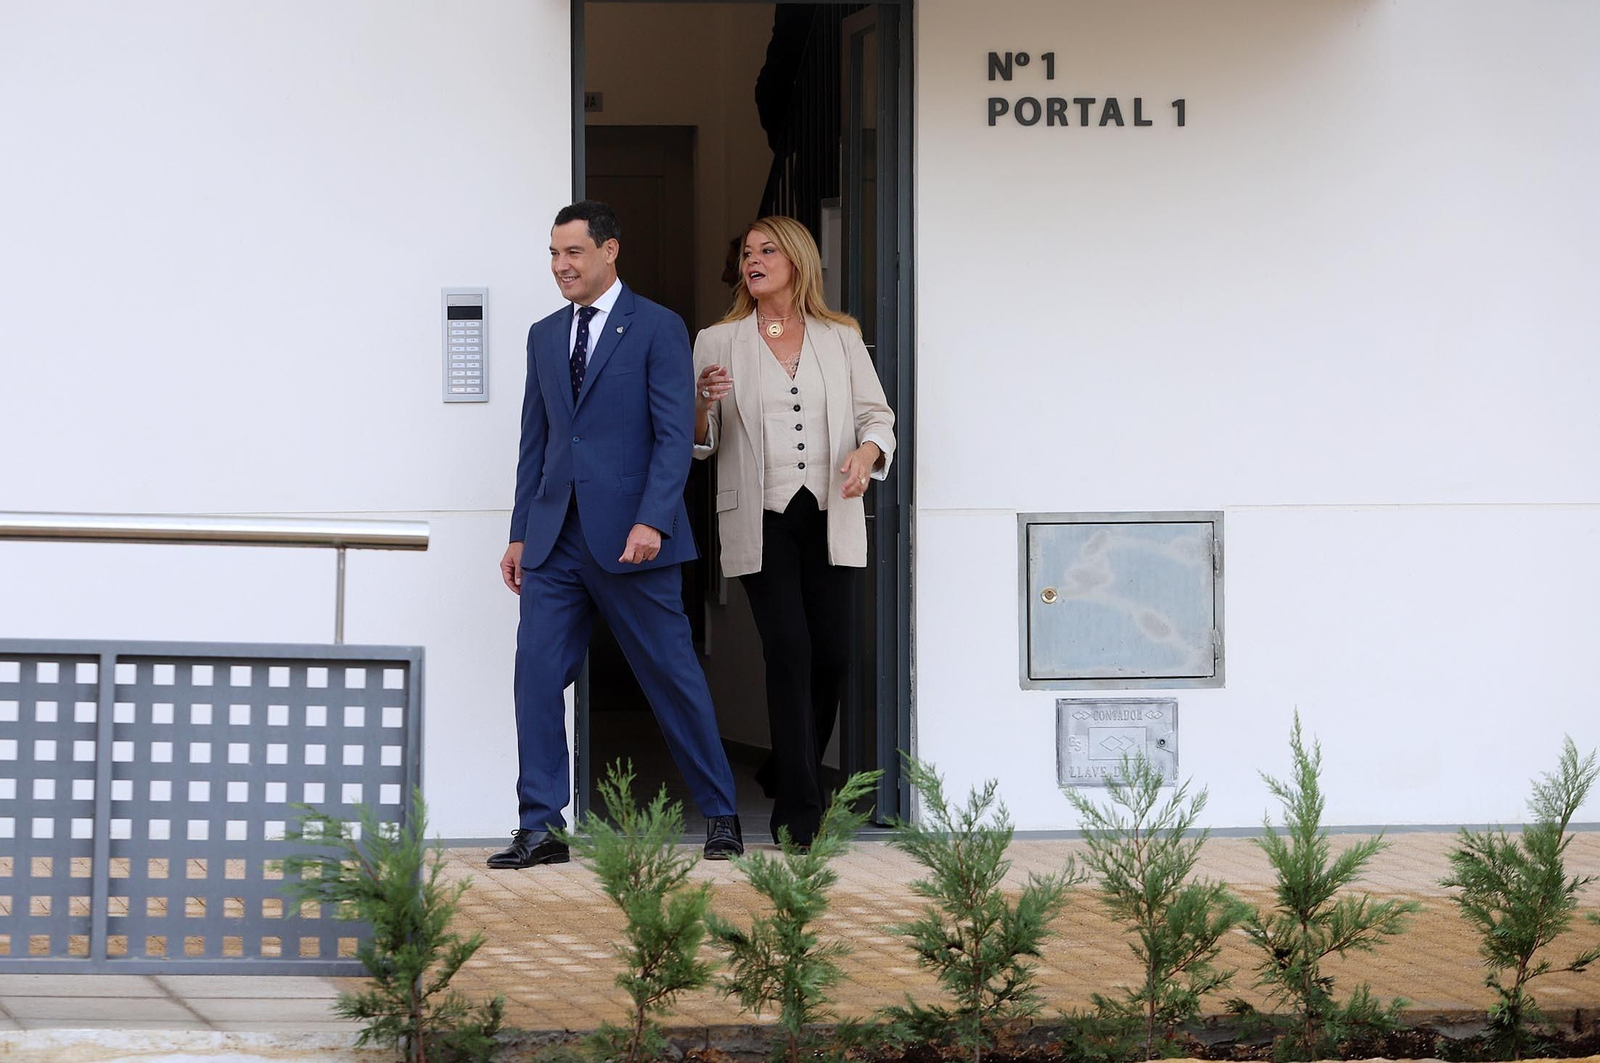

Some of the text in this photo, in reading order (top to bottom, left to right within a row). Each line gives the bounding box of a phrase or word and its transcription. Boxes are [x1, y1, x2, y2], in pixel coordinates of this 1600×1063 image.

[987, 51, 1055, 81] Nº 1
[987, 96, 1186, 127] PORTAL 1
[1092, 709, 1143, 721] CONTADOR
[1069, 765, 1107, 778] LLAVE
